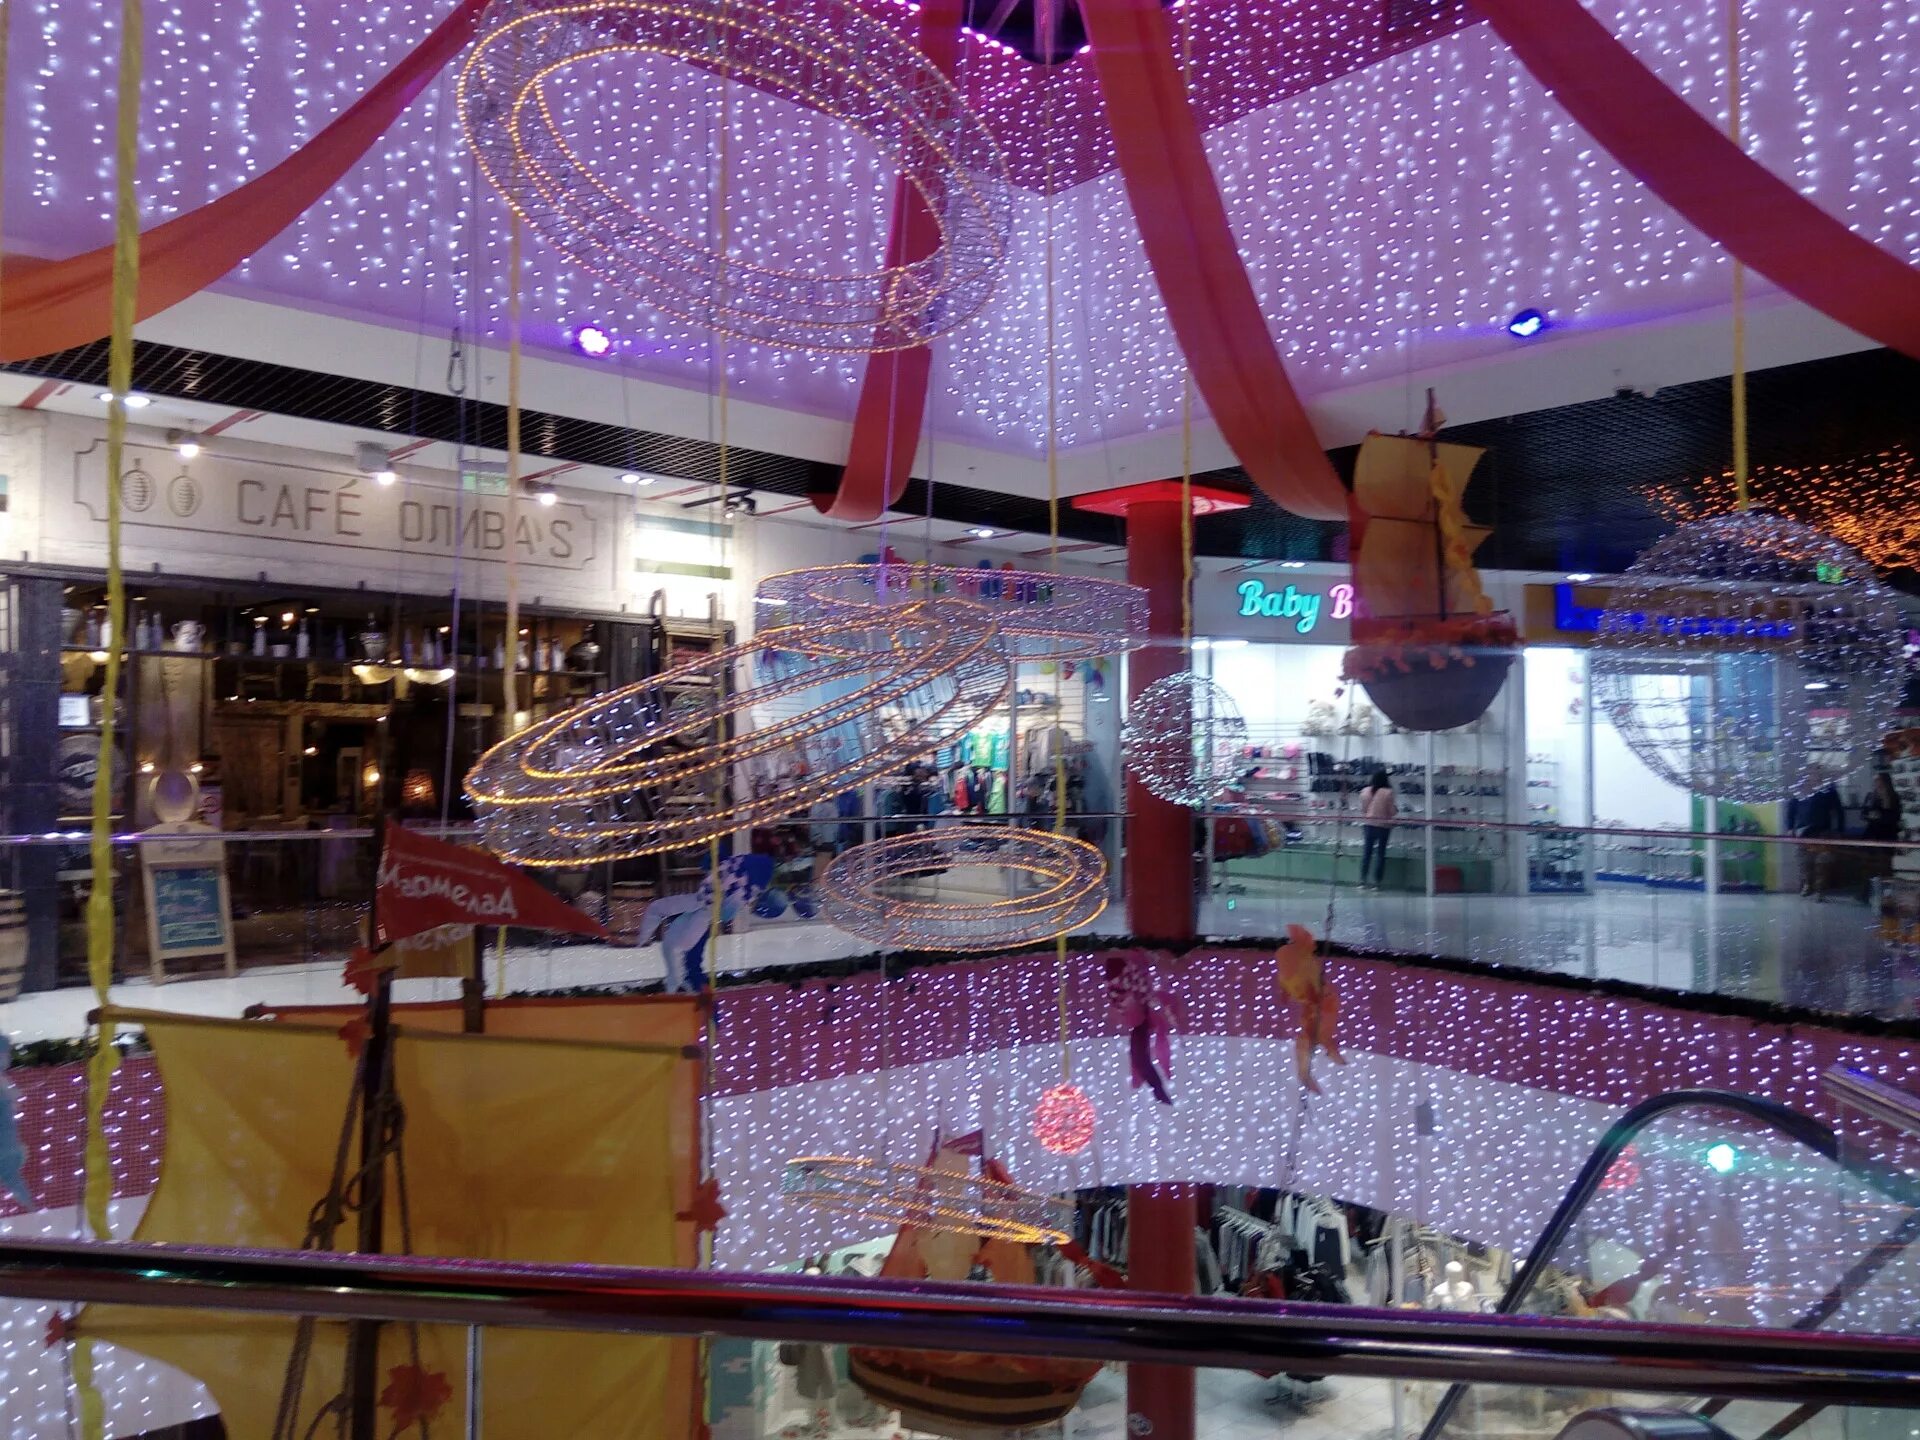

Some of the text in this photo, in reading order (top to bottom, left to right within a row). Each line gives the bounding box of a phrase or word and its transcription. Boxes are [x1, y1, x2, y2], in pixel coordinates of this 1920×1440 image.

[237, 479, 362, 536] CAFÉ
[1238, 580, 1355, 633] Baby B
